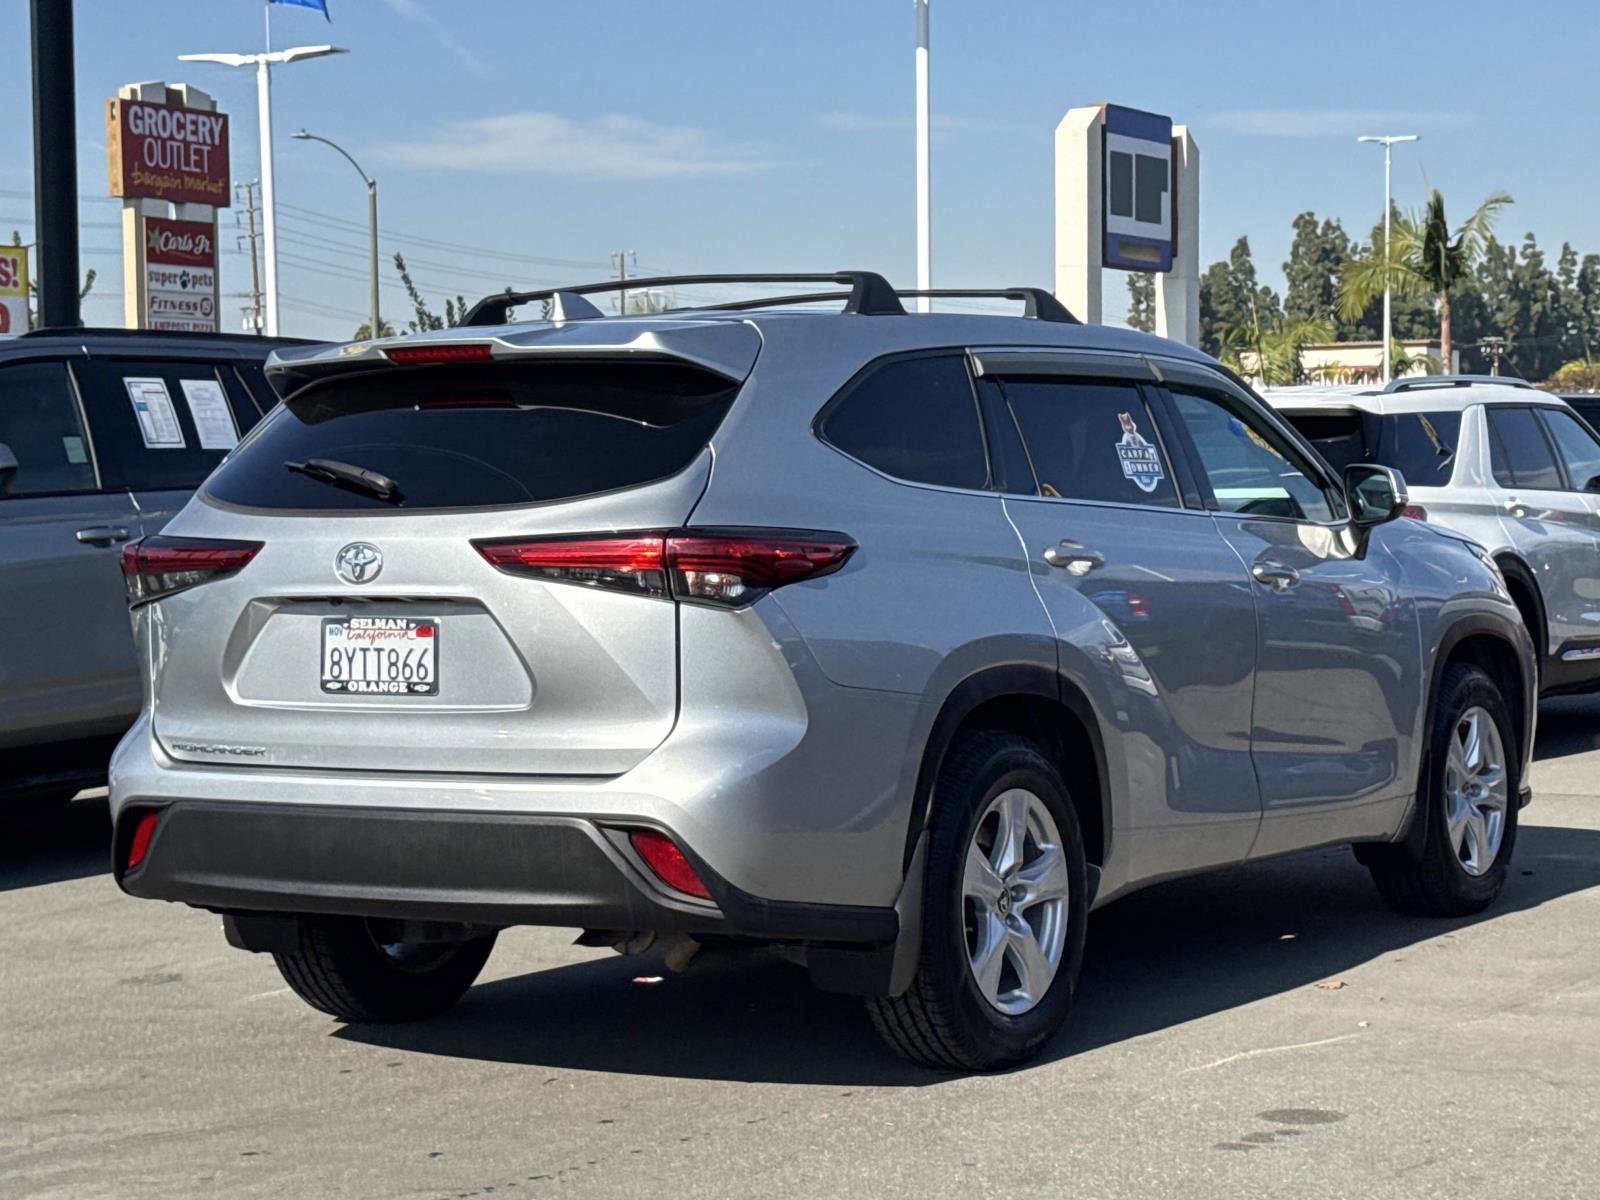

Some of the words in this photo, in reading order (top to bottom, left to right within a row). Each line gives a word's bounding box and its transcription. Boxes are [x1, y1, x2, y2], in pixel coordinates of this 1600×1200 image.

[128, 104, 223, 146] GROCERY
[143, 137, 211, 174] OUTLET
[149, 271, 179, 287] super
[191, 272, 213, 289] pets
[350, 618, 408, 630] SELMAN
[329, 646, 429, 681] 8YTT866
[347, 680, 408, 693] ORANGE
[171, 743, 266, 757] HIGHLANDER
